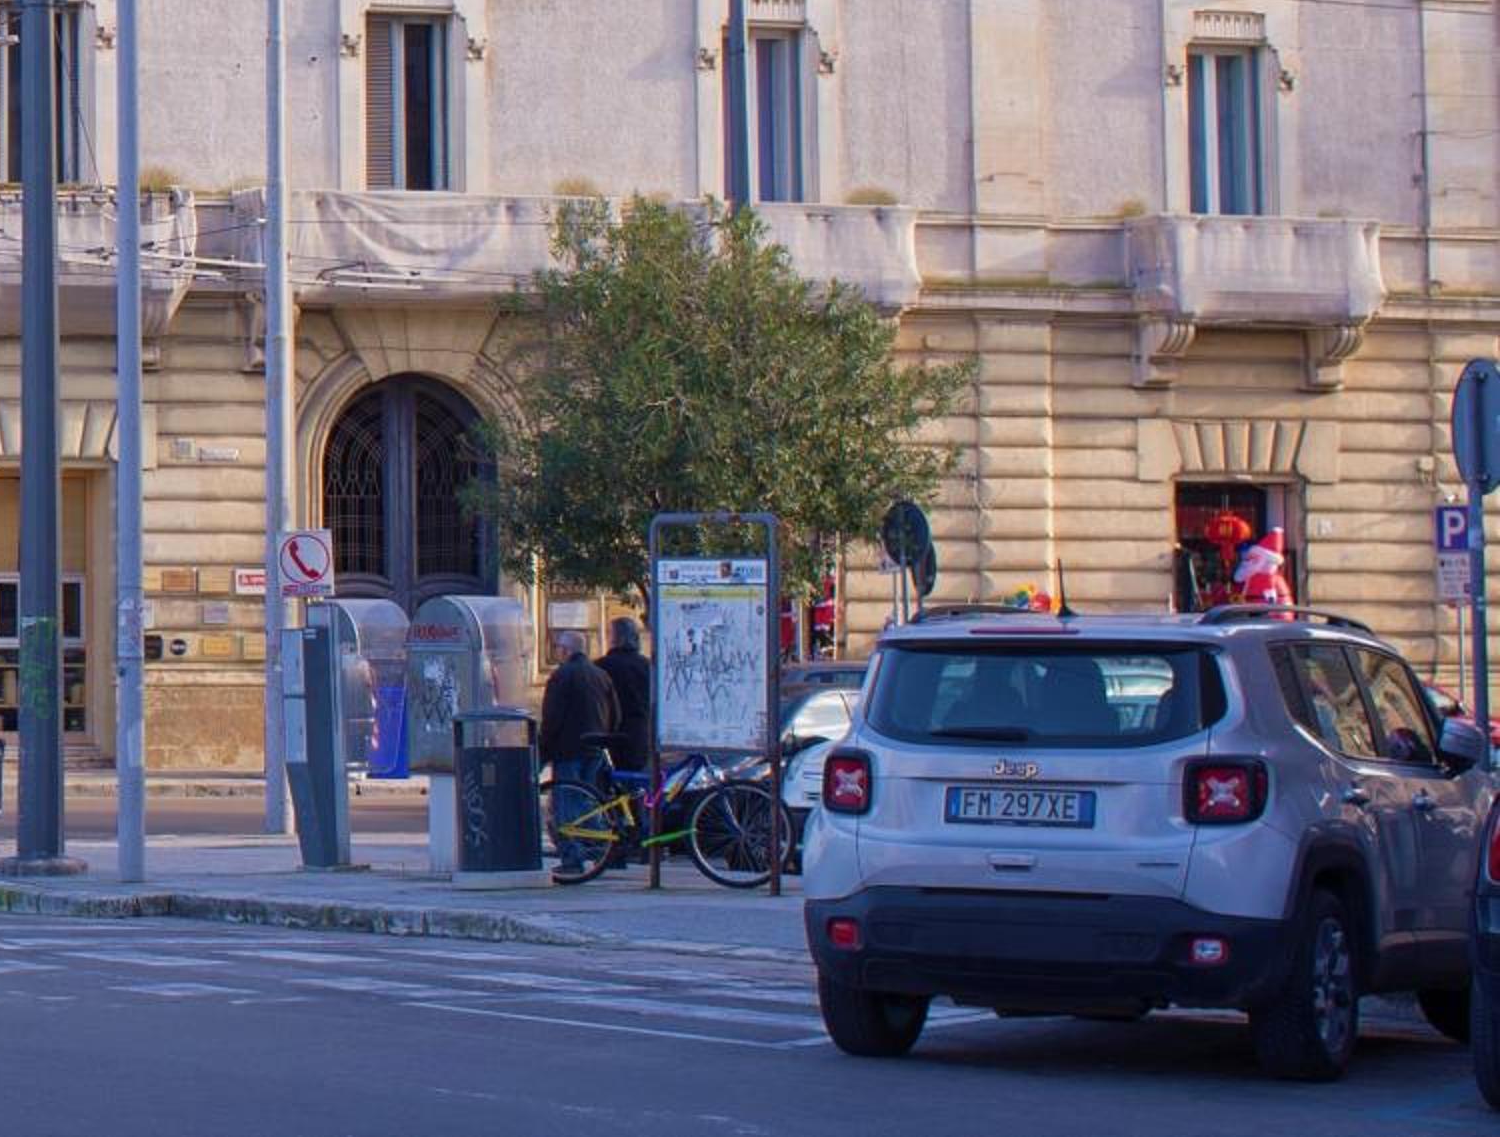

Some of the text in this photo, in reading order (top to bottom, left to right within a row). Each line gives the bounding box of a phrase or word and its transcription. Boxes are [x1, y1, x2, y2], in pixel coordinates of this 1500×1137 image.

[1443, 510, 1465, 547] P
[995, 760, 1037, 780] Jeep
[963, 792, 1077, 820] FM 297XE
